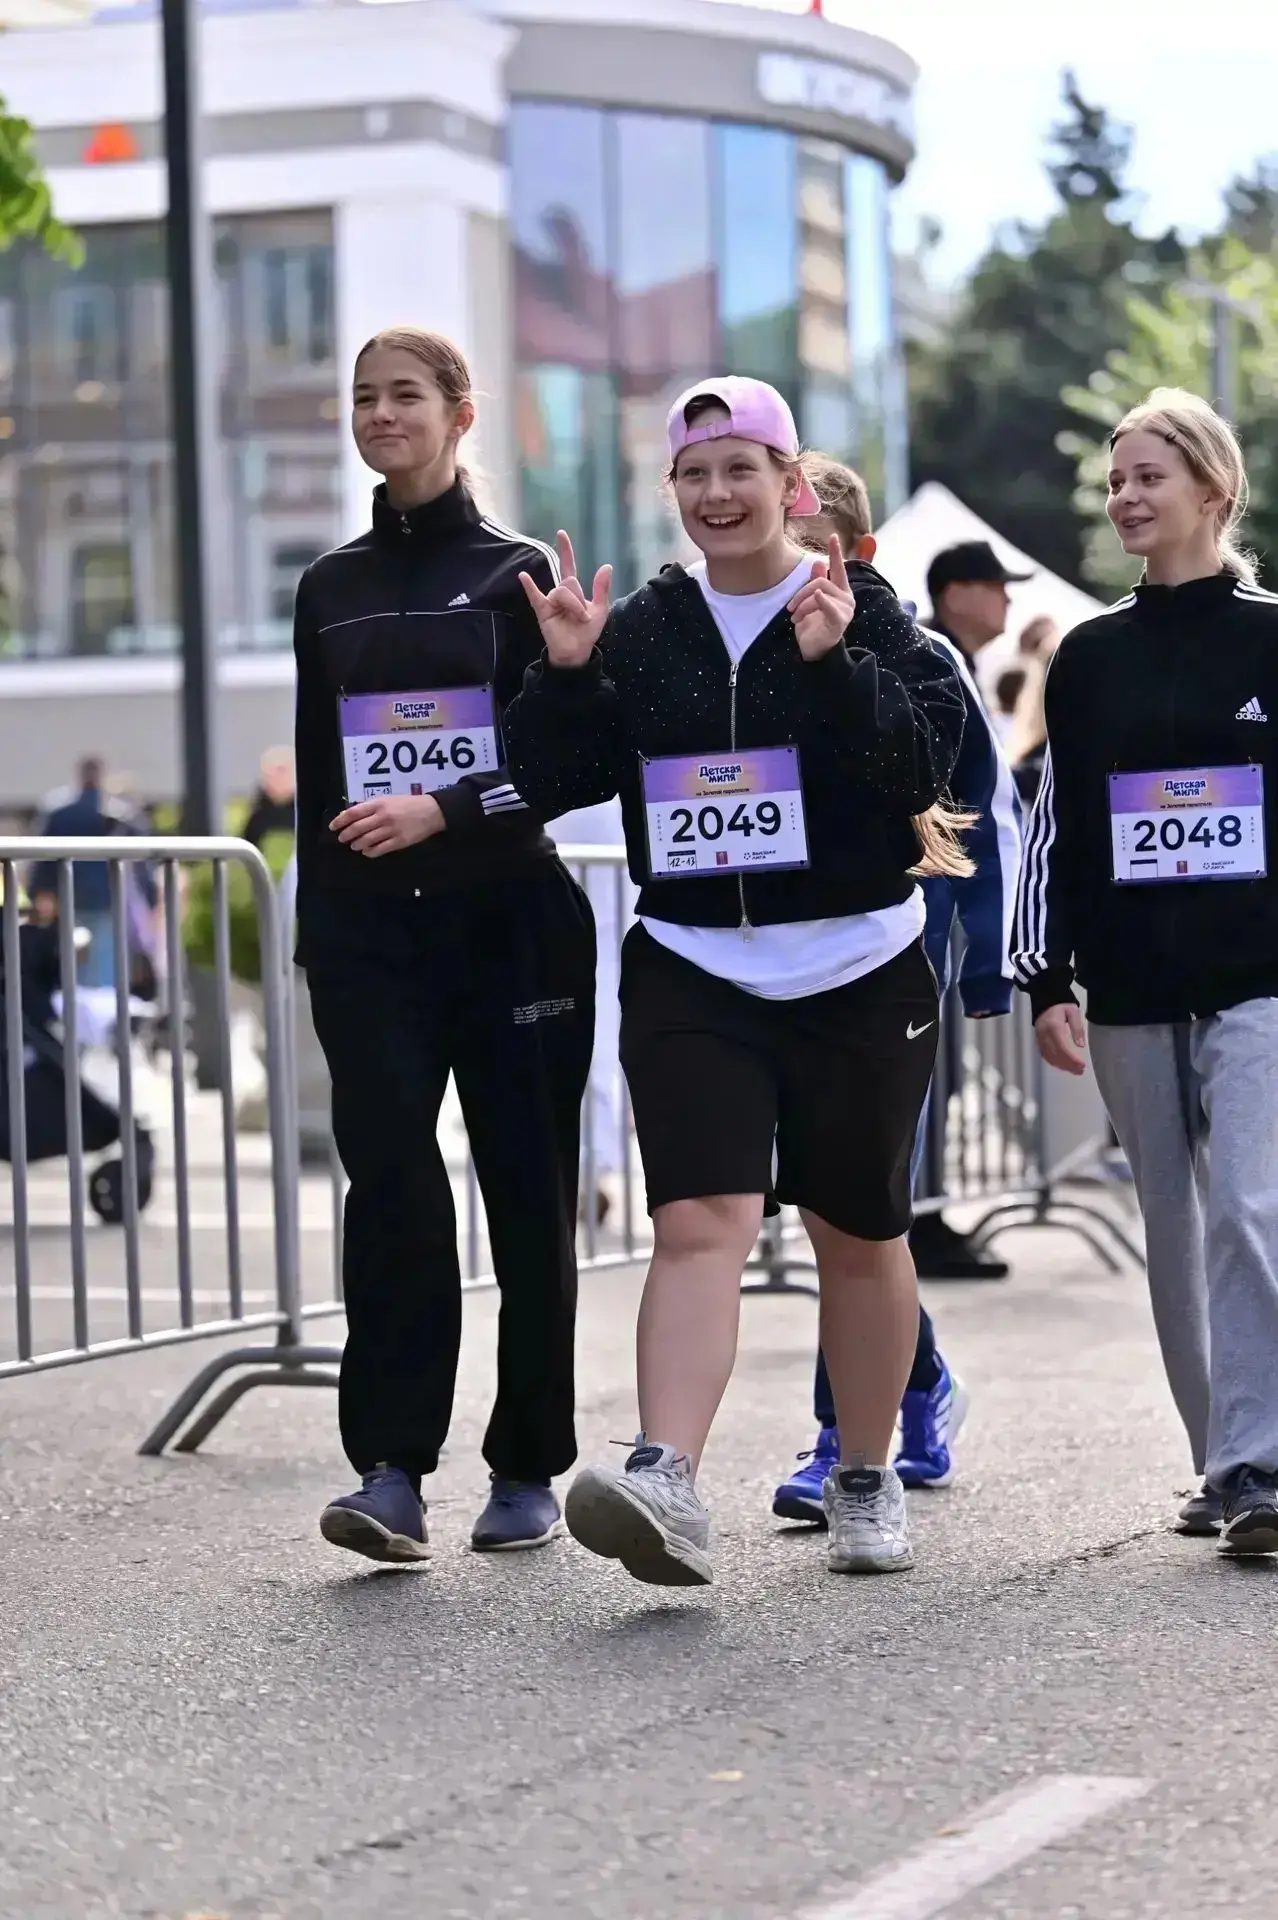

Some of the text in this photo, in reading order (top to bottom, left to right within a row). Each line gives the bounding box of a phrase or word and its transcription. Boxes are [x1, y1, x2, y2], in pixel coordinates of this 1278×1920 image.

[394, 702, 436, 713] Детская
[403, 710, 430, 719] миля
[1235, 712, 1268, 722] adidas
[365, 736, 476, 775] 2046
[699, 765, 742, 777] Детская
[708, 773, 736, 783] миля
[1165, 780, 1206, 791] Детская
[1173, 788, 1200, 797] миля
[670, 801, 782, 843] 2049
[1133, 815, 1242, 852] 2048
[669, 856, 696, 868] 12-13
